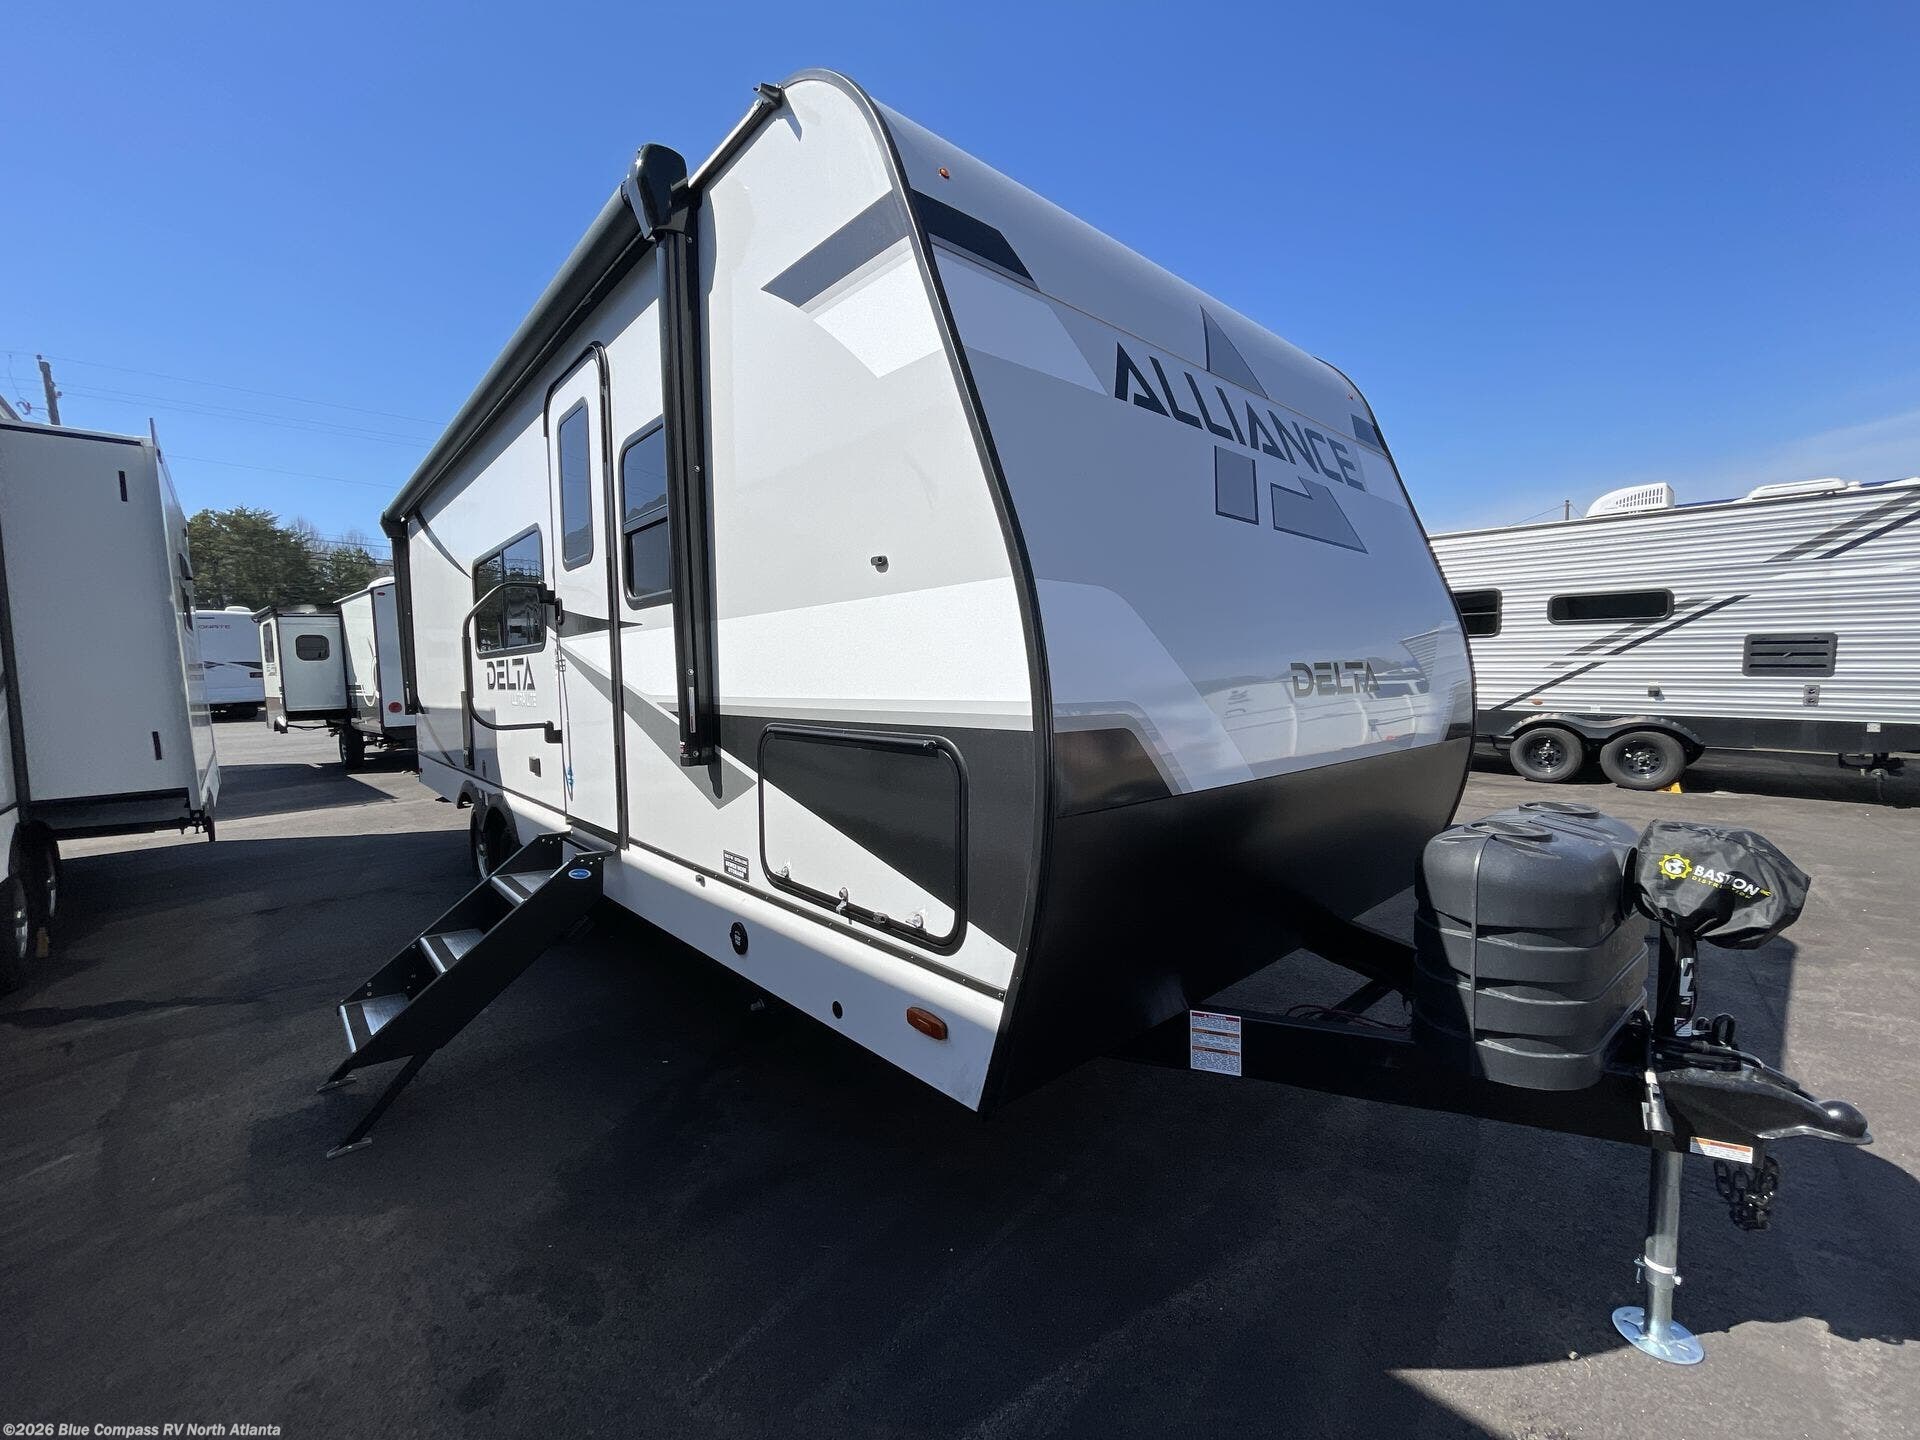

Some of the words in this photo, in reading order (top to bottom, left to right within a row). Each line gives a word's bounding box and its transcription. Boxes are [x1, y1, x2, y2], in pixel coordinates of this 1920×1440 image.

[1114, 341, 1366, 492] ALLIANCE
[486, 656, 536, 690] DELTA
[1290, 661, 1380, 698] DELTA
